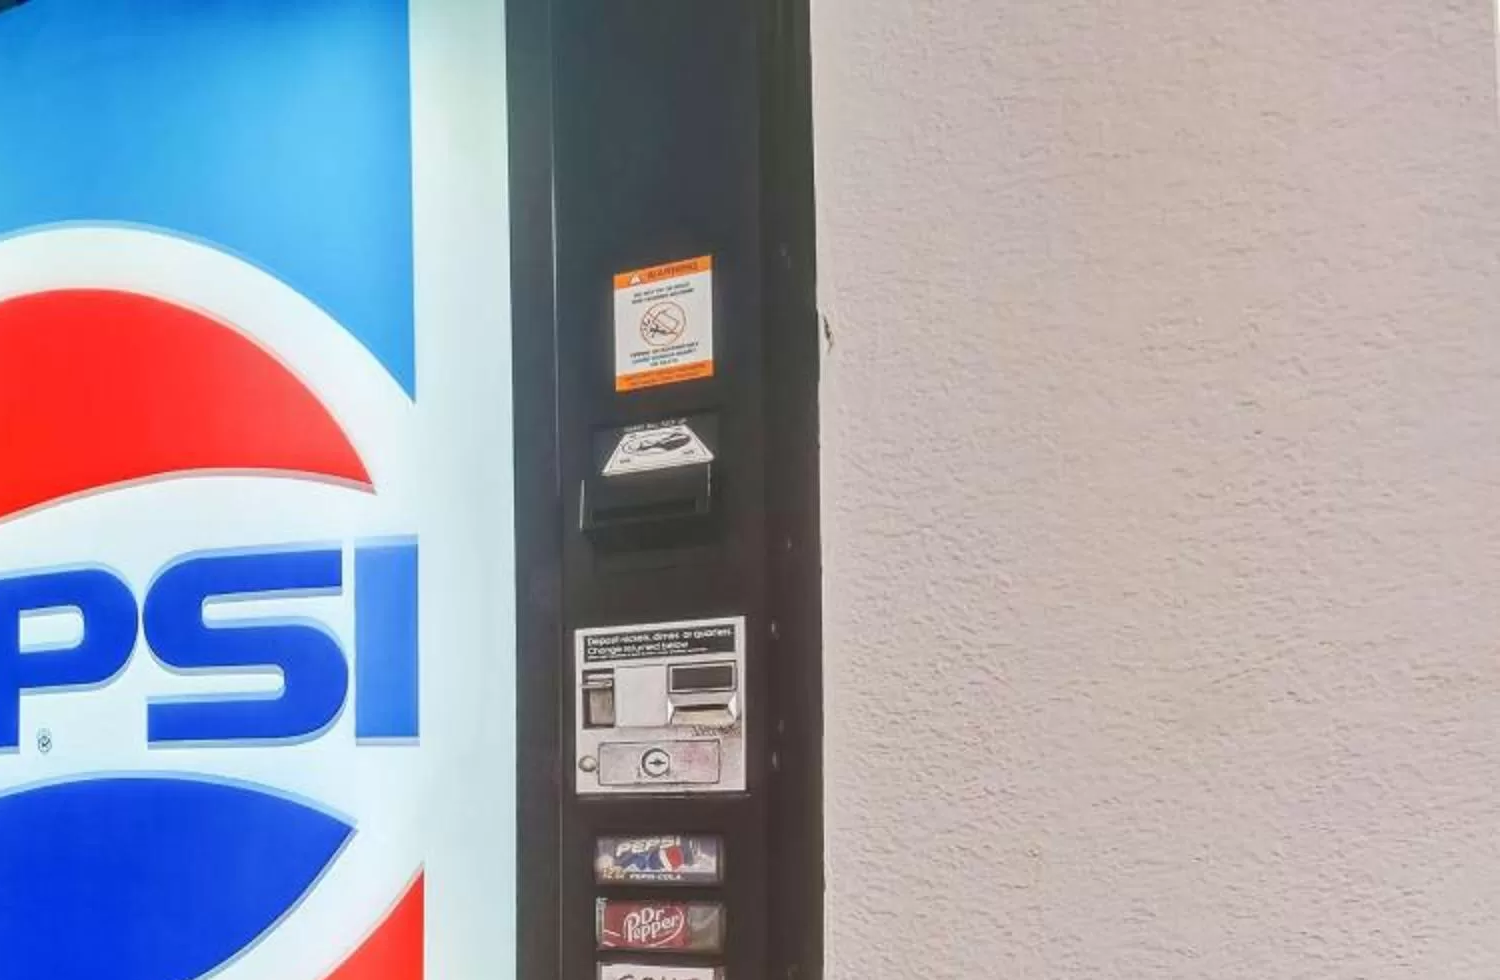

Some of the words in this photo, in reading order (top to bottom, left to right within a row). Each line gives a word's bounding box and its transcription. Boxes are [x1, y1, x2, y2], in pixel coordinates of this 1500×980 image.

[616, 836, 681, 857] PEPSI
[641, 907, 664, 924] Dr
[623, 911, 680, 943] Pepper
